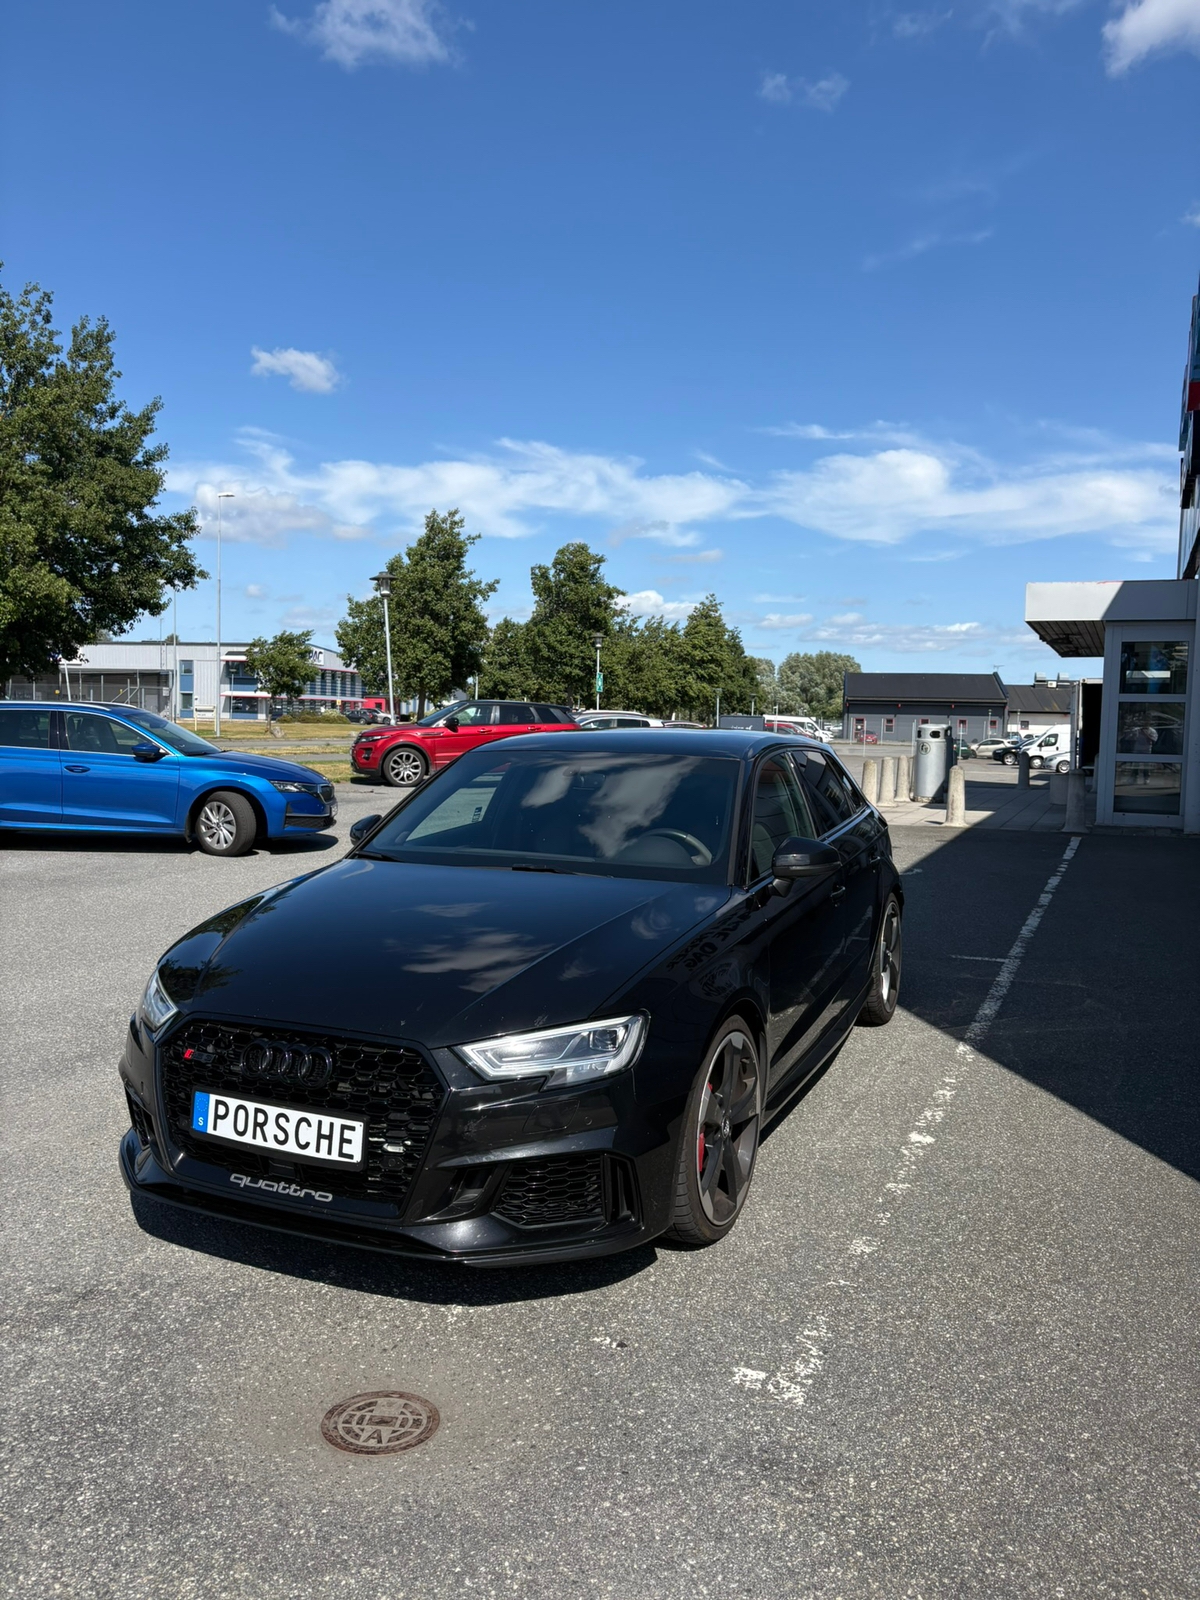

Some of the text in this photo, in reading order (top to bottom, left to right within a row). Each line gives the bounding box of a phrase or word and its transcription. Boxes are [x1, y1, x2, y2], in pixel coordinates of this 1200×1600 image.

[197, 1098, 357, 1161] S PORSCHE
[229, 1172, 334, 1203] quattro
